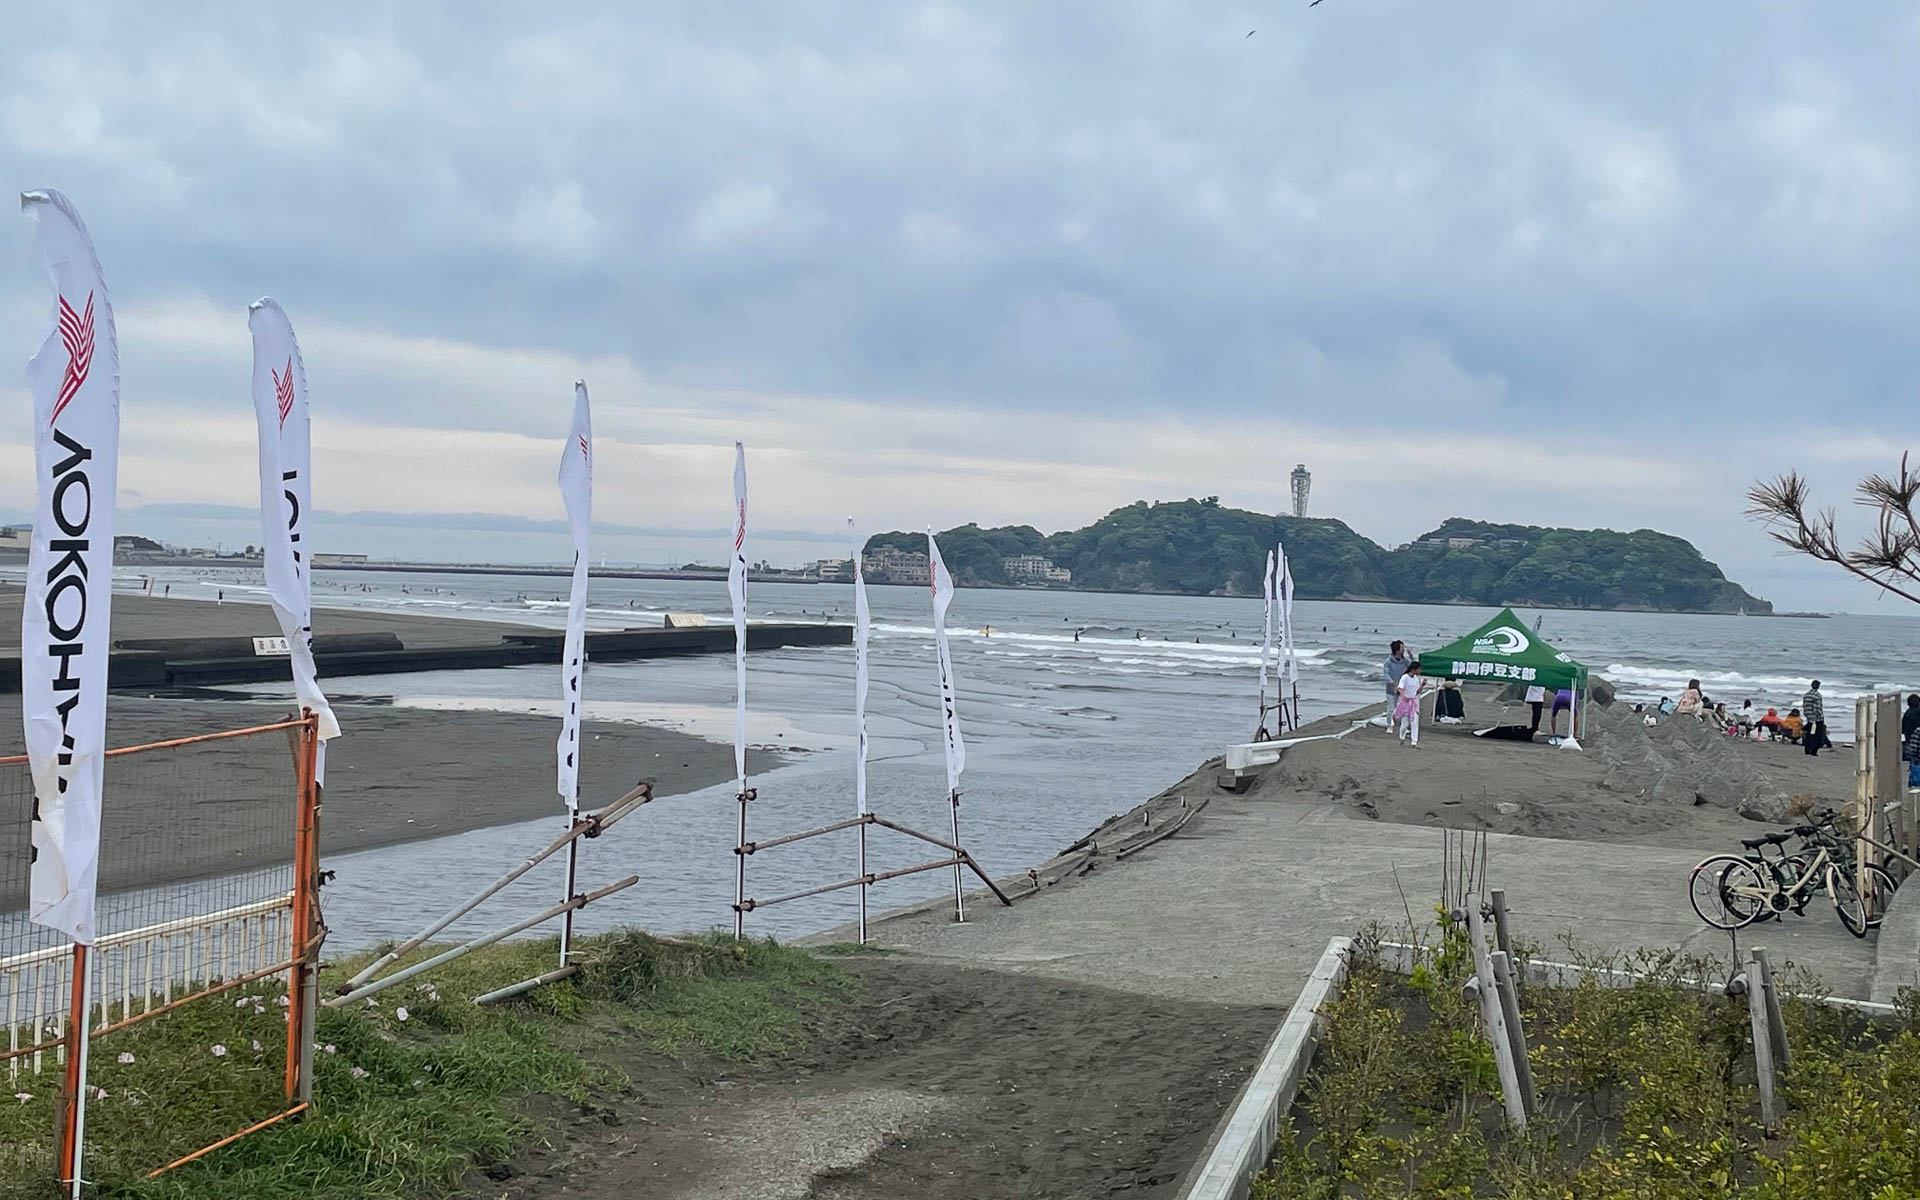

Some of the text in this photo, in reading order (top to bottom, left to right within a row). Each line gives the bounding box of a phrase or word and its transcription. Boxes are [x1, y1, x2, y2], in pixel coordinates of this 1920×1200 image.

[1473, 638, 1494, 646] NSA
[1451, 661, 1537, 681] 静岡伊豆支部
